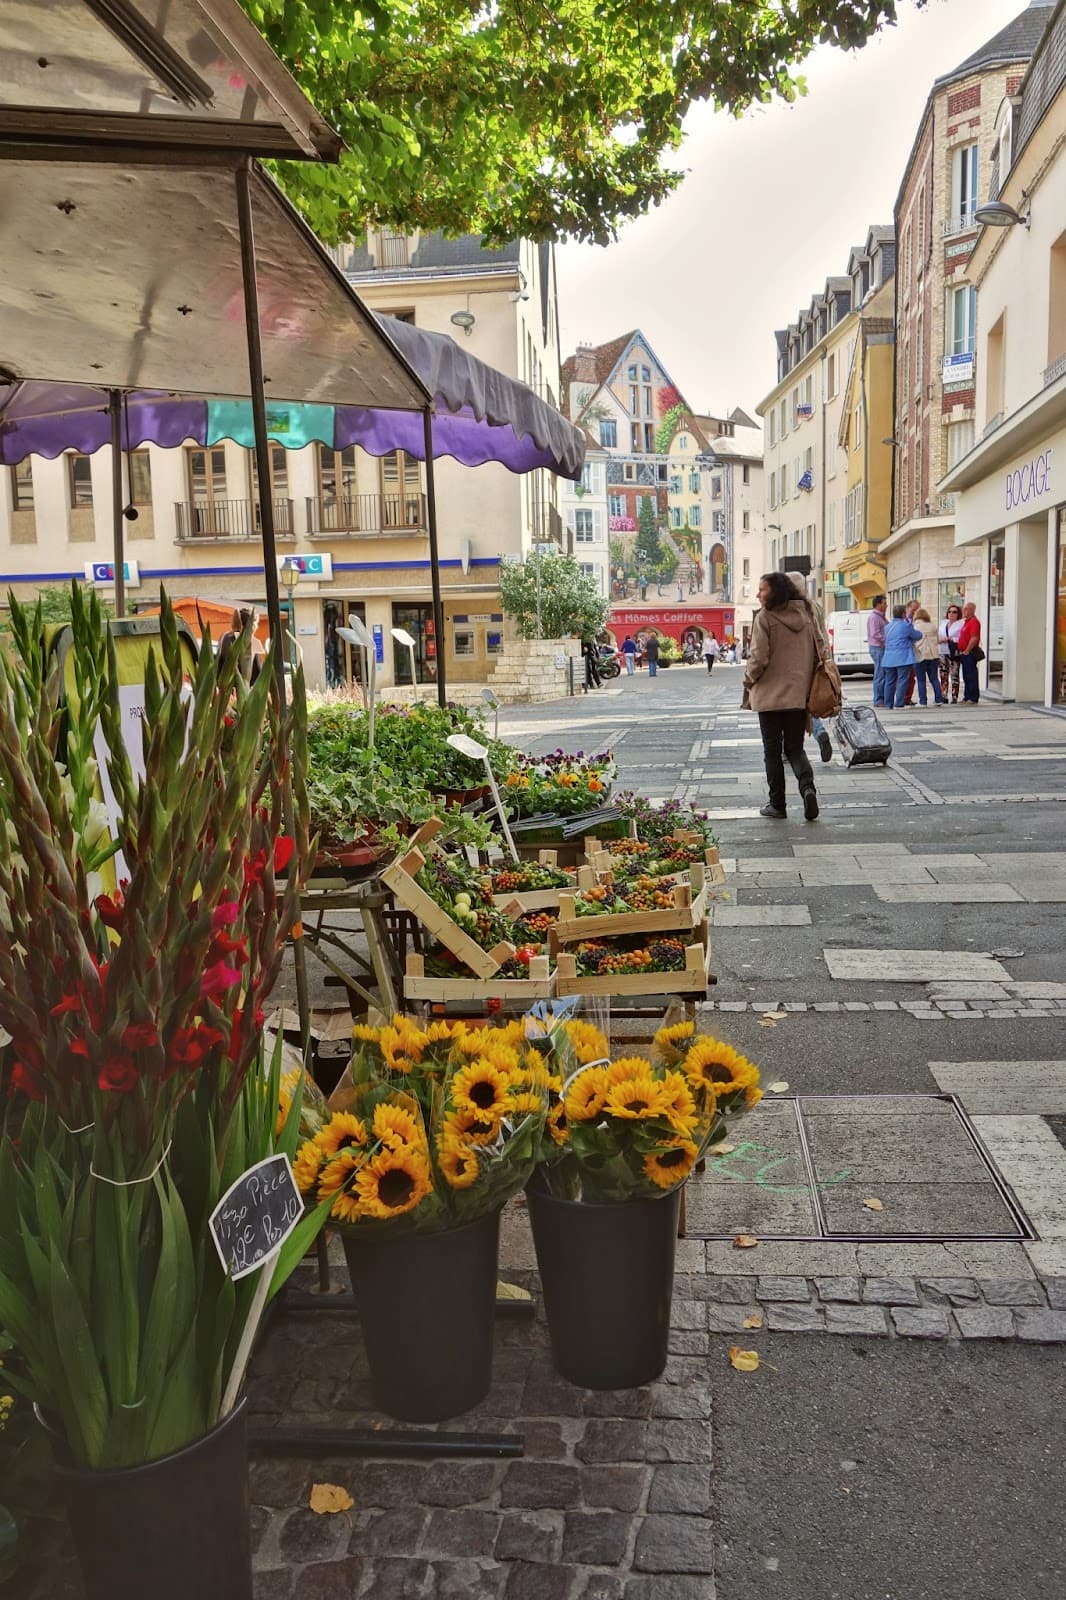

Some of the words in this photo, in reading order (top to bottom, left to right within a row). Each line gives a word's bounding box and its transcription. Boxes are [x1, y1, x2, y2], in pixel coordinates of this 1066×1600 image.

[1006, 449, 1052, 511] BOCAGE
[663, 611, 704, 623] Coiffure
[246, 1170, 287, 1206] Pièce
[281, 1197, 297, 1224] 10
